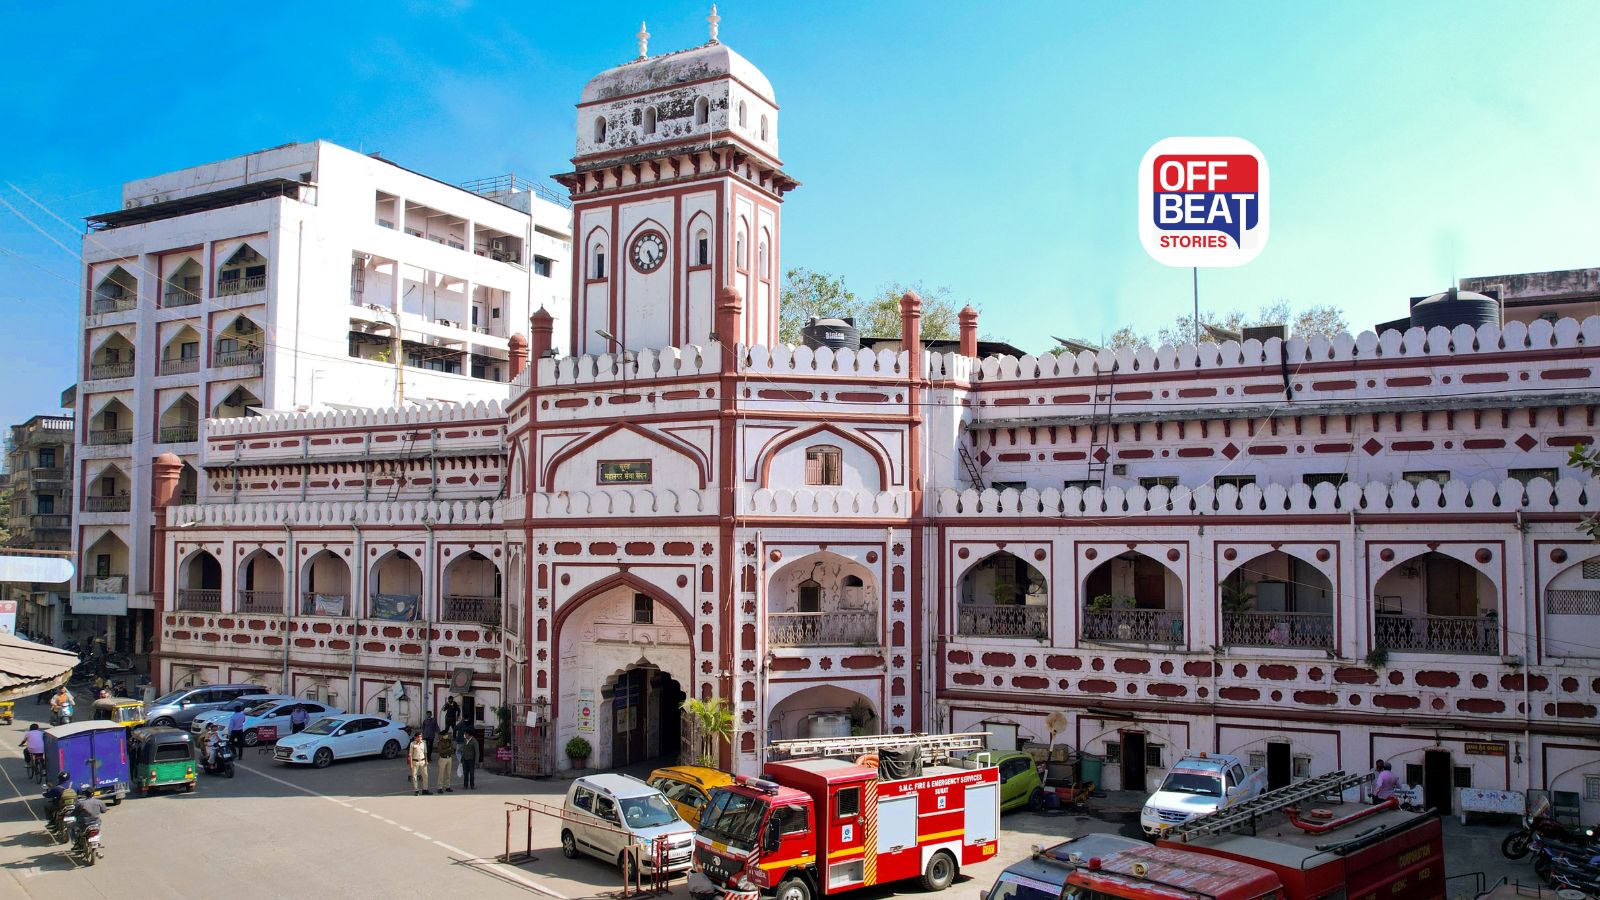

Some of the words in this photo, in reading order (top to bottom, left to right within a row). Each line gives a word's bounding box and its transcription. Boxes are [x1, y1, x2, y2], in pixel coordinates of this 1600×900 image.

[914, 781, 926, 790] FIRE
[926, 780, 931, 788] &
[931, 777, 960, 787] EMERGENCY
[960, 775, 982, 783] SERVICES
[935, 787, 948, 795] SURAT
[702, 862, 729, 878] EICHER
